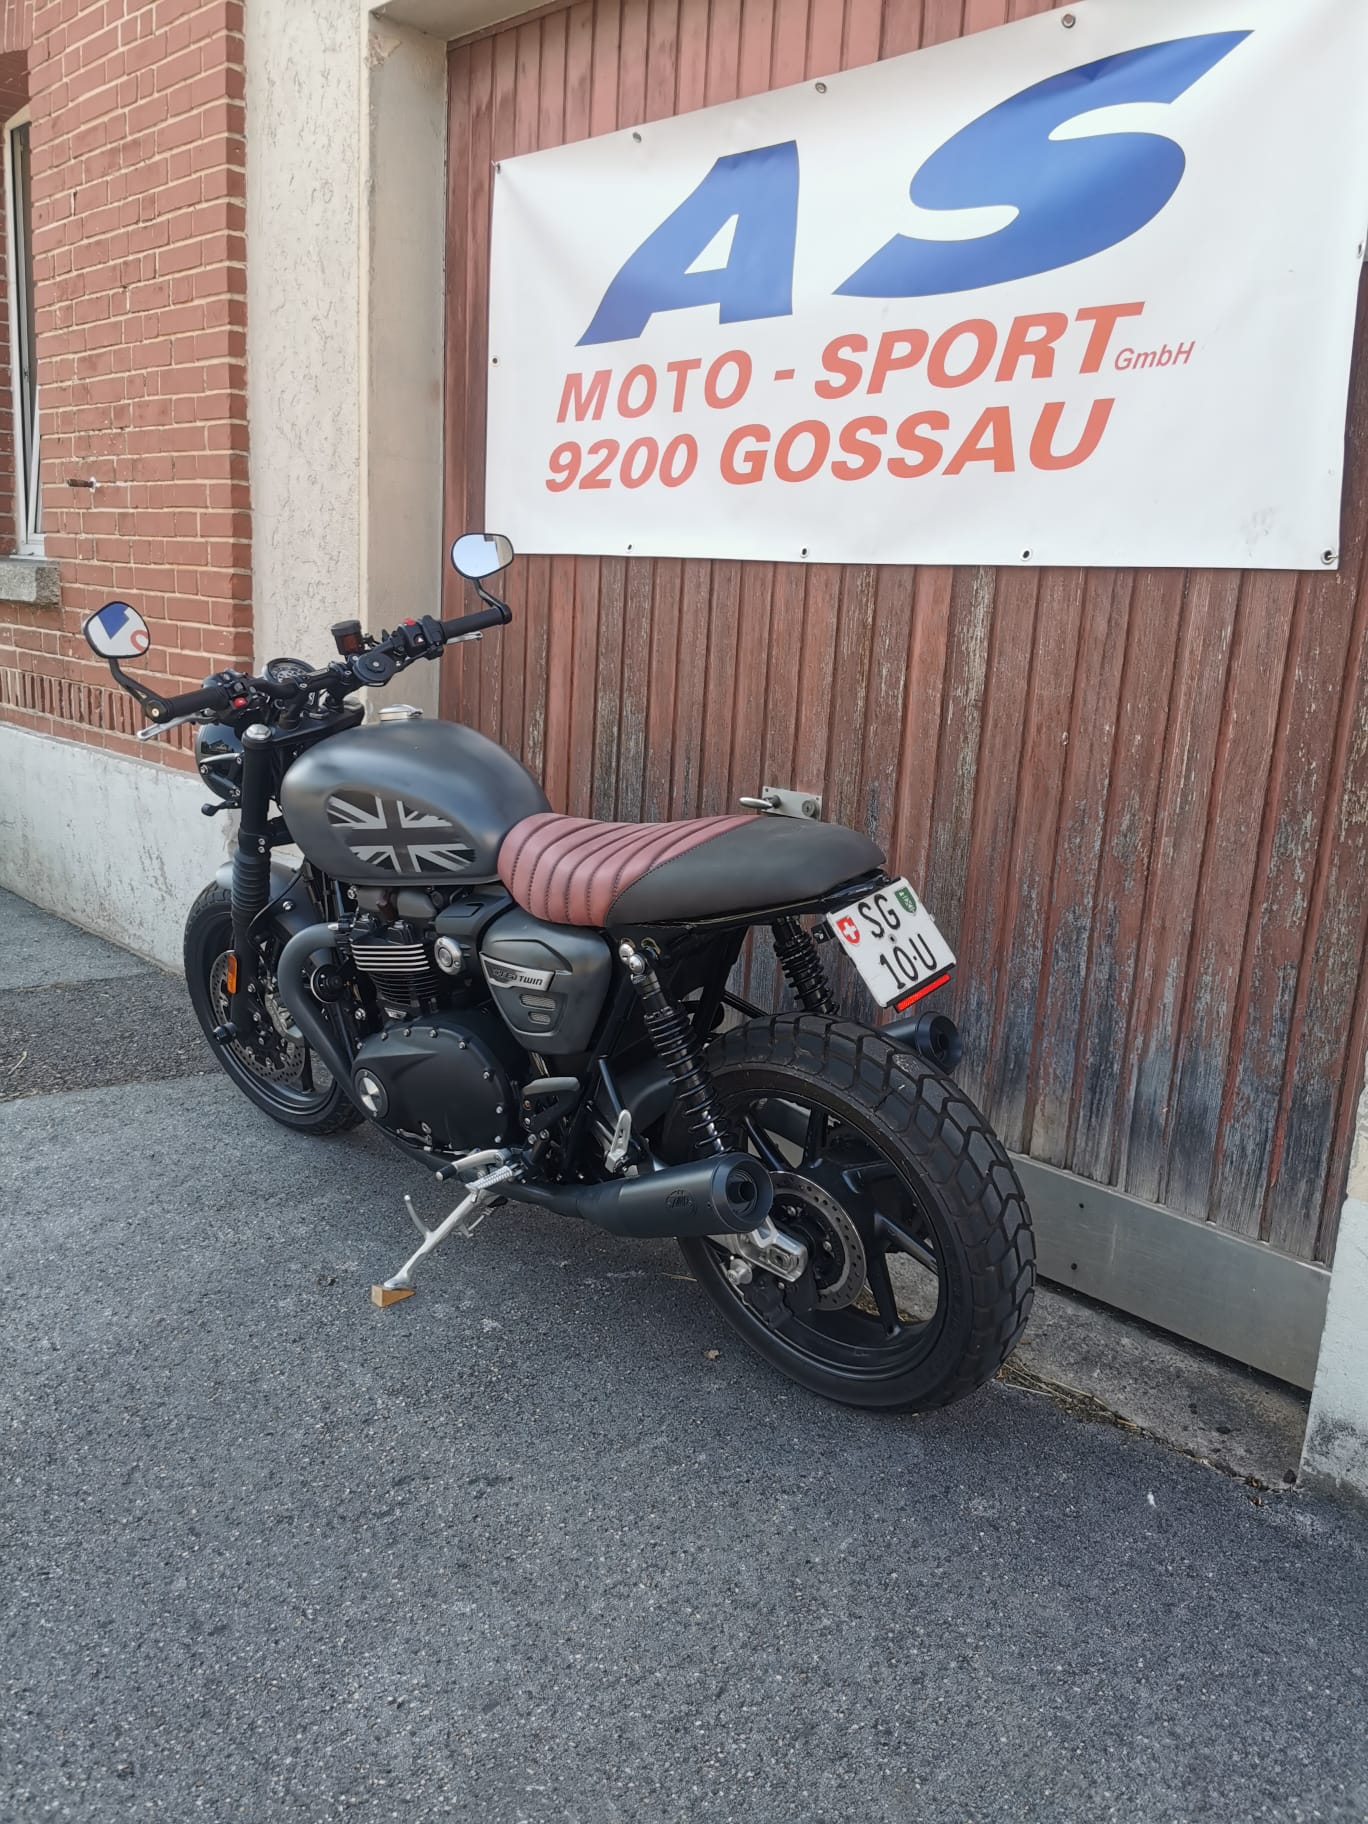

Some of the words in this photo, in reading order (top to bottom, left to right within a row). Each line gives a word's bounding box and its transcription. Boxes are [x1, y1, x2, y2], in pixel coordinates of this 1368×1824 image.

[555, 350, 753, 424] MOTO
[814, 302, 1145, 400] SPORT
[1114, 340, 1196, 371] GmbH
[545, 433, 698, 492] 9200
[719, 398, 1115, 486] GOSSAU
[858, 893, 901, 939] SG
